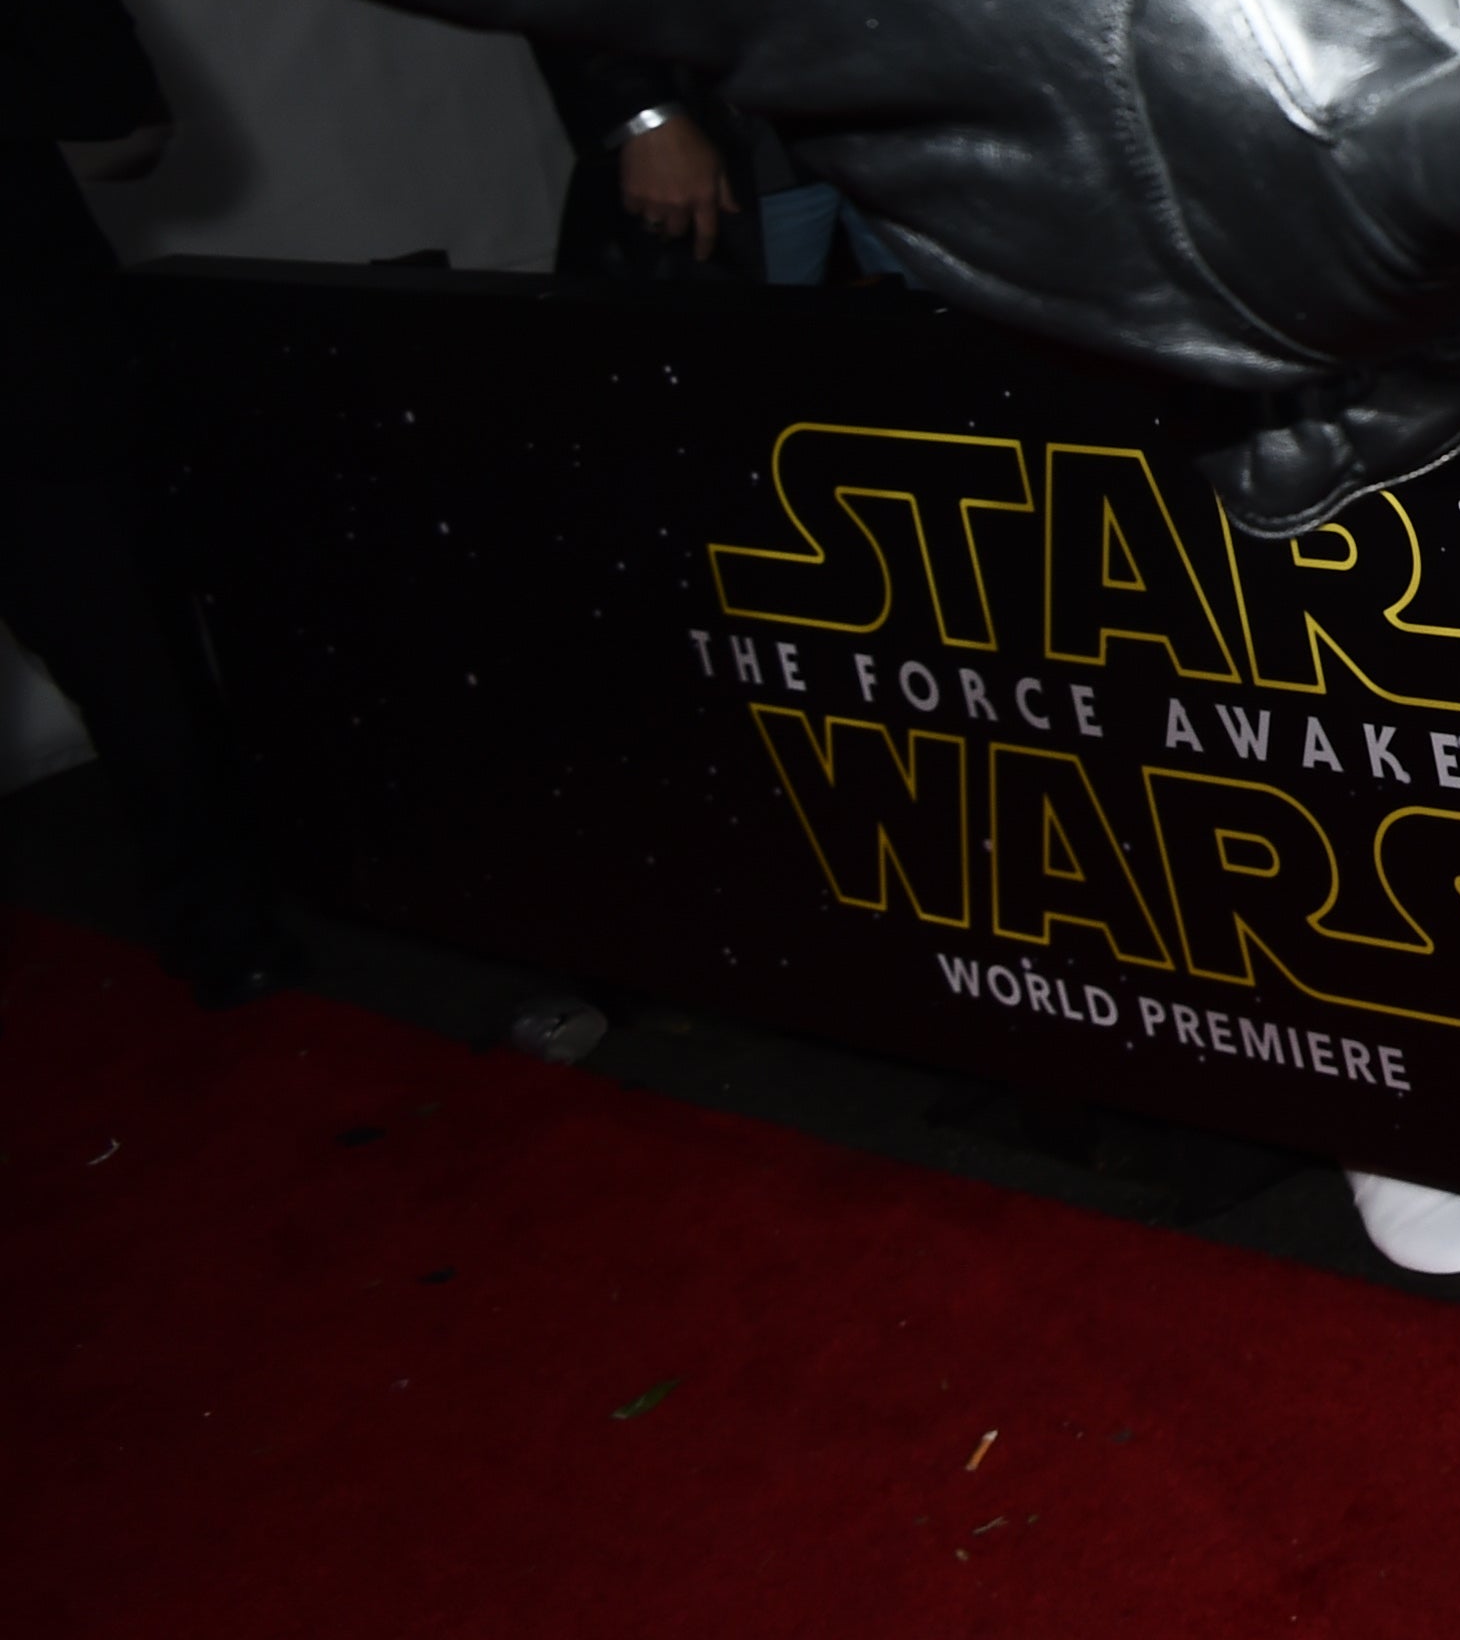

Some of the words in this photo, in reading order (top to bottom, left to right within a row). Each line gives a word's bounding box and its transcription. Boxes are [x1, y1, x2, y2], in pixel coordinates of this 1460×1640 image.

[687, 627, 808, 693] THE
[853, 652, 1104, 739] FORCE
[936, 952, 1119, 1028] WORLD
[1137, 995, 1412, 1092] PREMIERE
